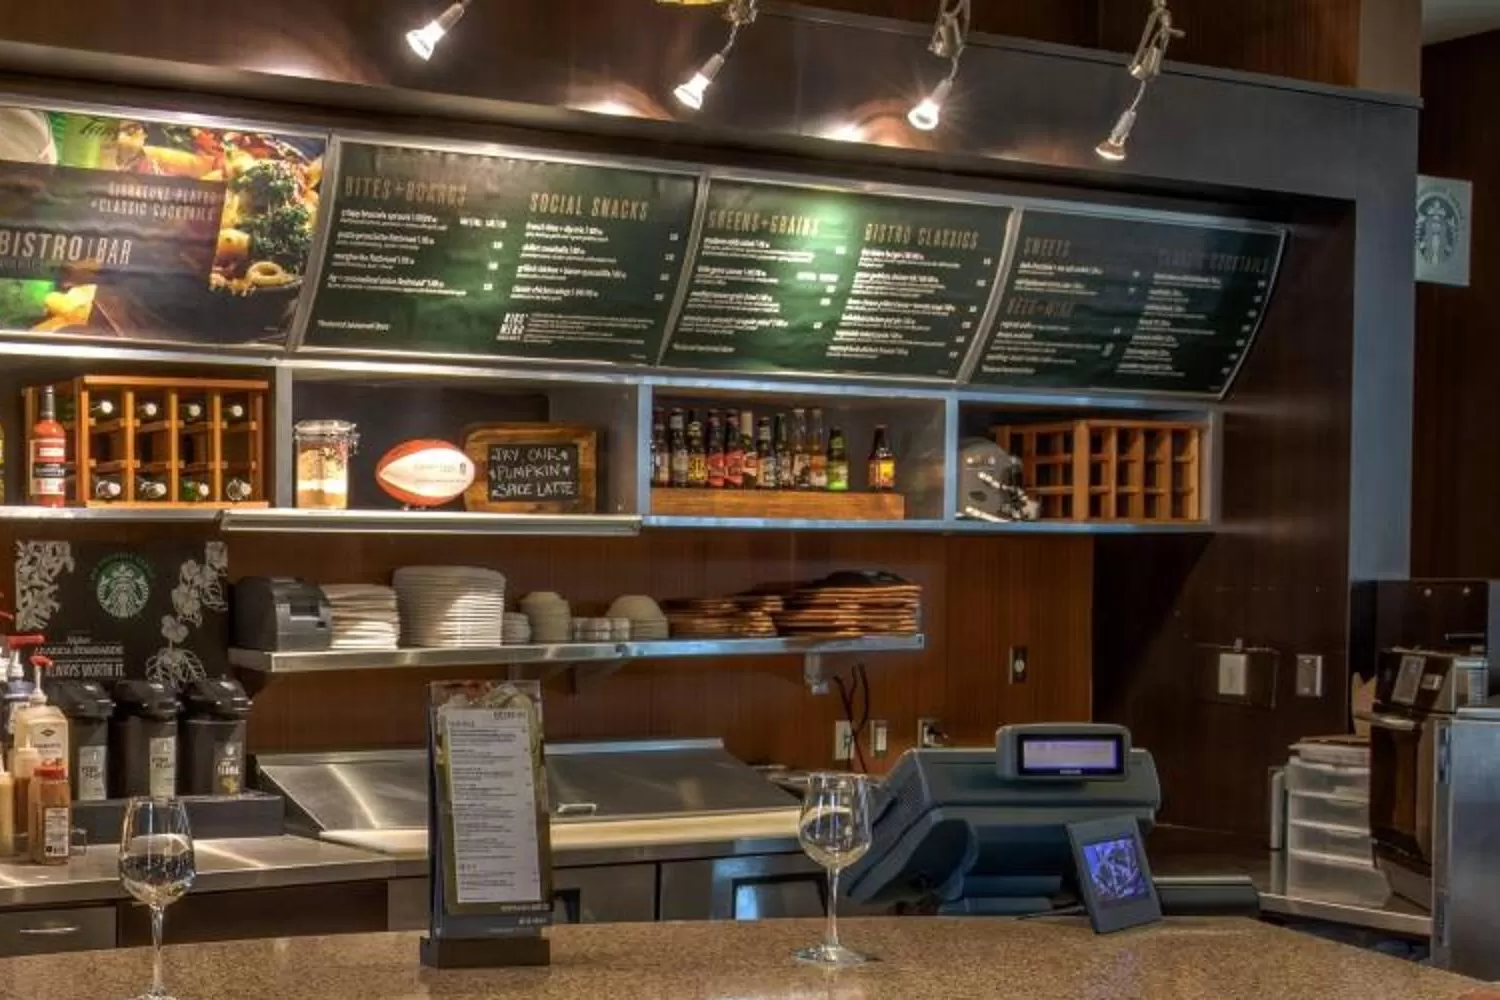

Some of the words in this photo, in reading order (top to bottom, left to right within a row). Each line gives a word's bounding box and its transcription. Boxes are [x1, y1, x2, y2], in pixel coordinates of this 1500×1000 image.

[529, 191, 583, 216] SOCIAL
[591, 195, 649, 222] SNACKS
[95, 237, 132, 265] BAR
[496, 463, 561, 481] PUMPKIN
[492, 483, 533, 498] SPICE
[537, 481, 575, 497] LATTE
